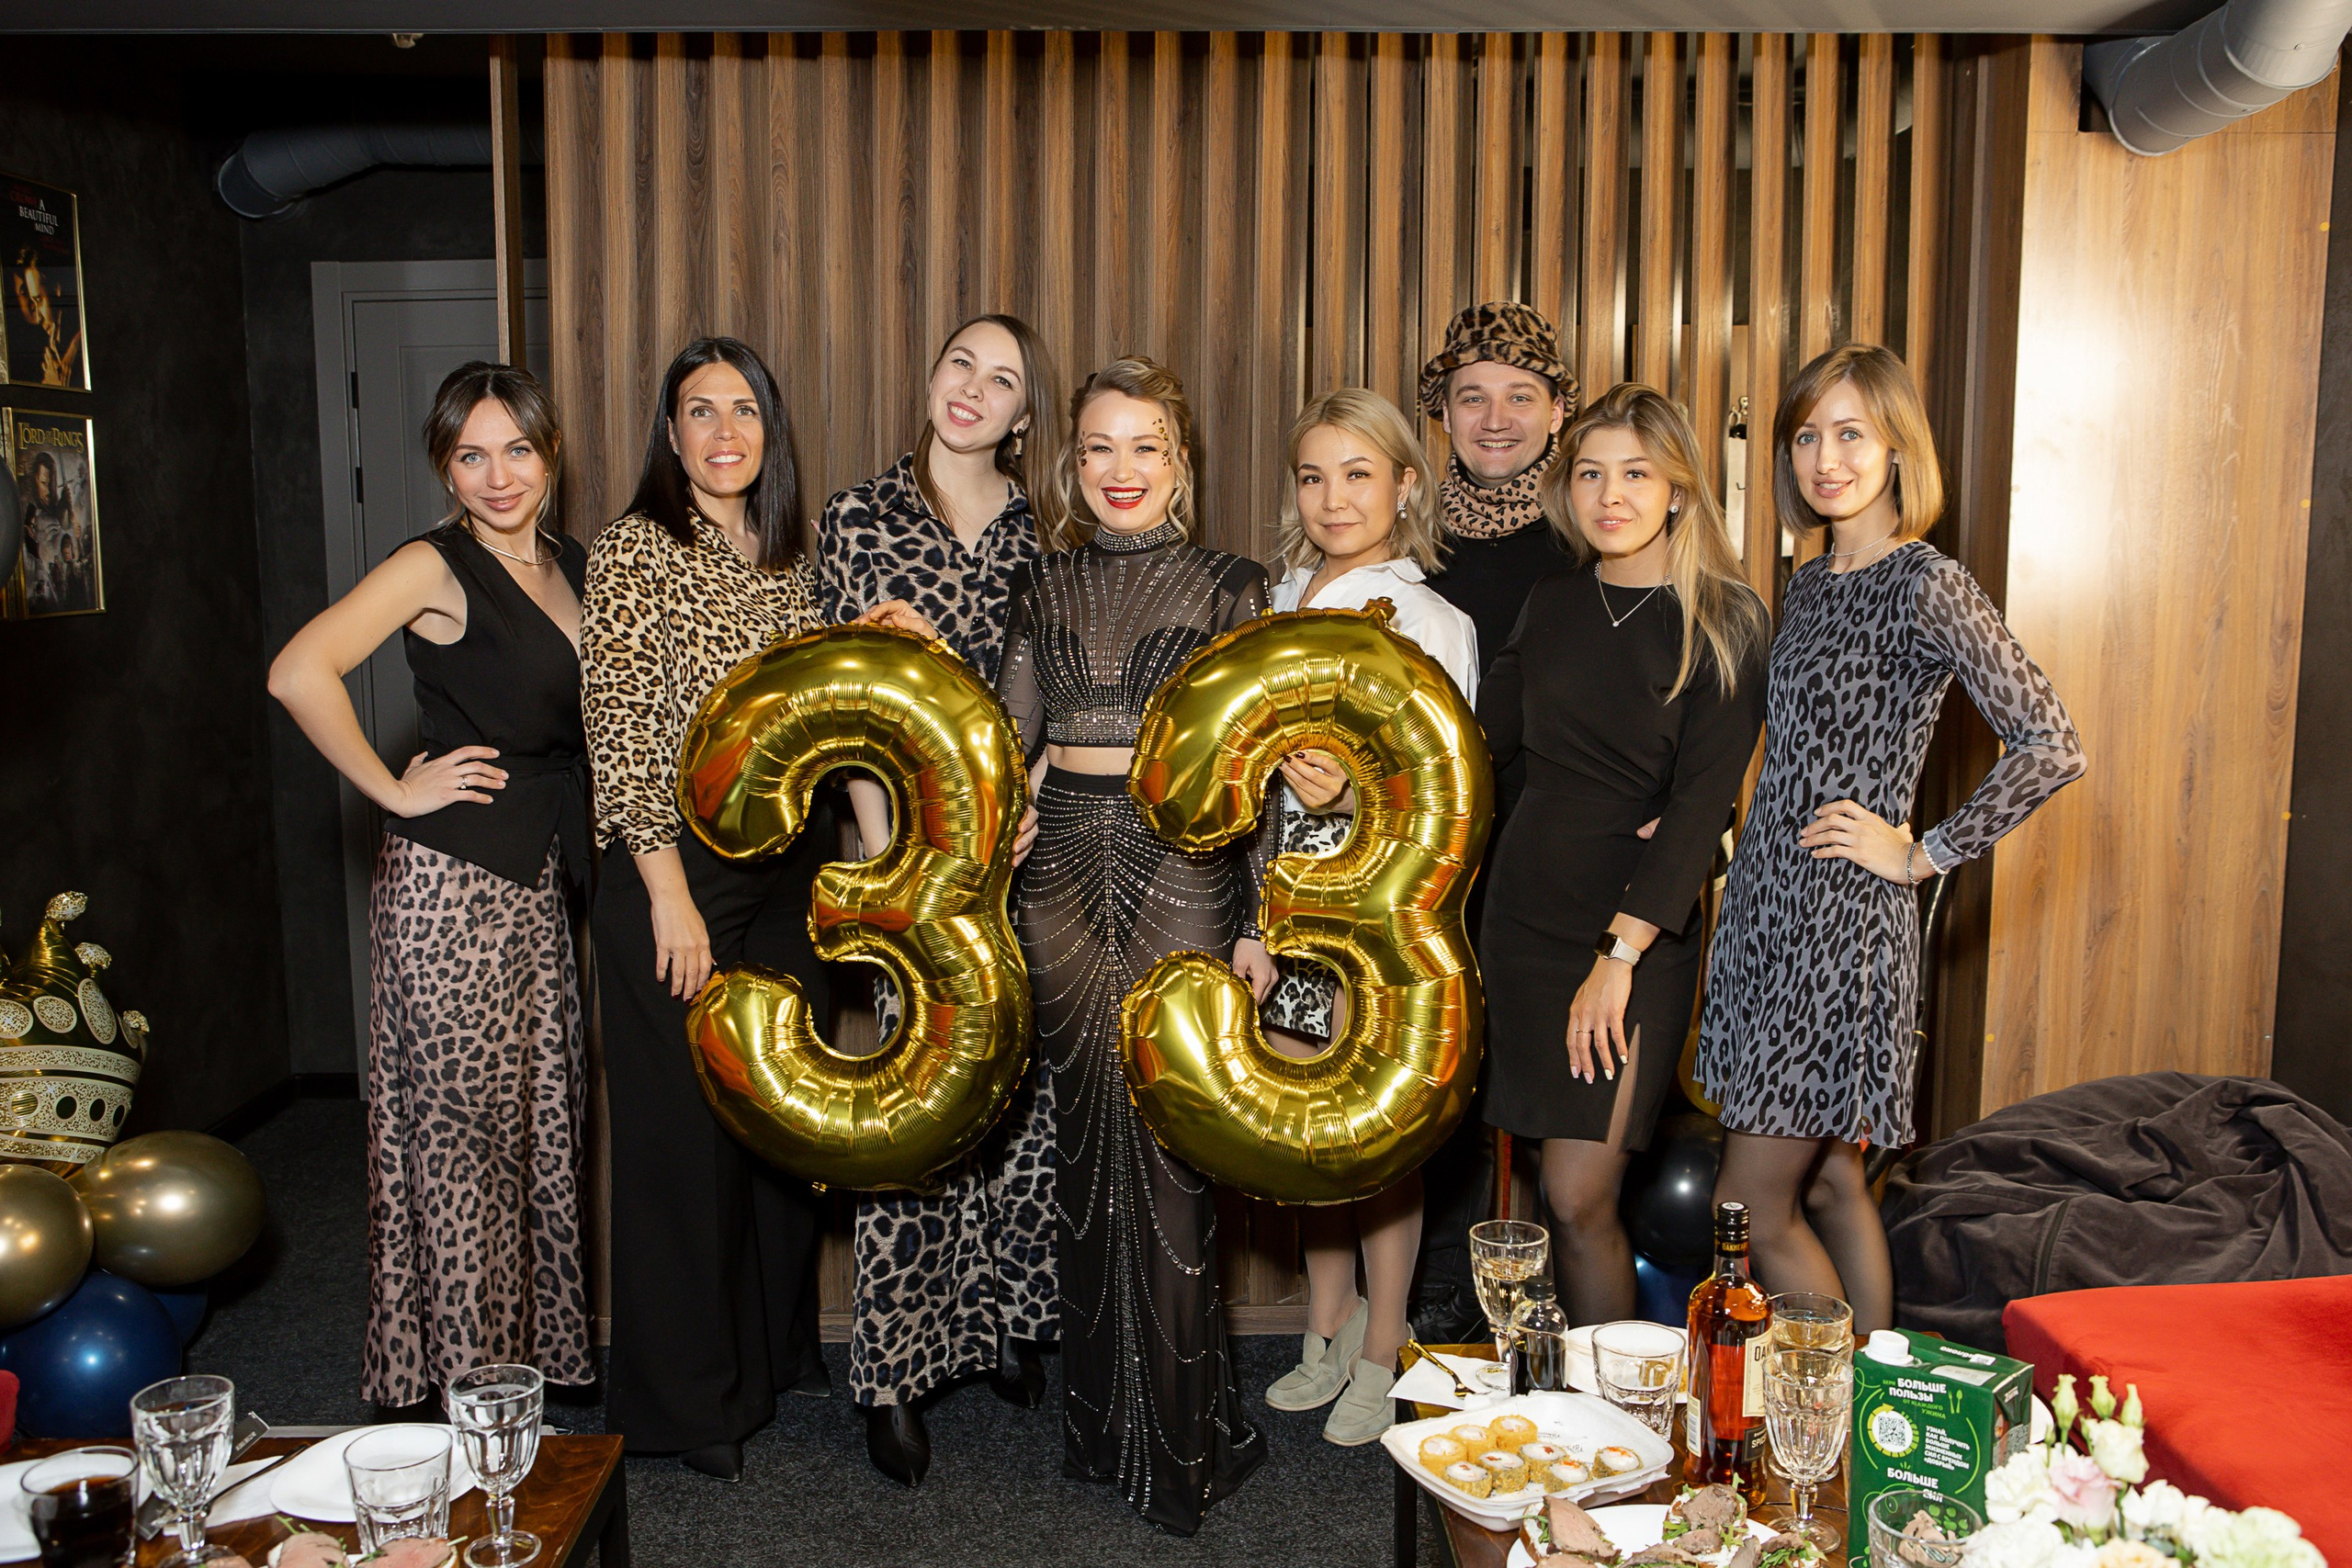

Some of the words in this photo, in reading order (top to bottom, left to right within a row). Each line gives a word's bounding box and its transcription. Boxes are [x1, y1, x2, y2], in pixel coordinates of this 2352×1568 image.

[39, 198, 46, 211] A
[17, 205, 60, 227] BEAUTIFUL
[34, 221, 54, 236] MIND
[17, 422, 46, 450] LORD
[51, 427, 85, 454] RINGS
[1897, 1378, 1947, 1393] БОЛЬШЕ
[1889, 1387, 1934, 1403] ПОЛЬЗЫ
[1911, 1399, 1944, 1411] КАЖДОГО
[1921, 1408, 1946, 1419] УЖИНА
[1925, 1438, 1950, 1450] БОЛЬШЕ
[1926, 1431, 1939, 1440] КАК
[1939, 1435, 1971, 1450] ПОЛУЧИТЬ
[1924, 1450, 1937, 1459] СИЛ
[1887, 1467, 1939, 1489] БОЛЬШЕ
